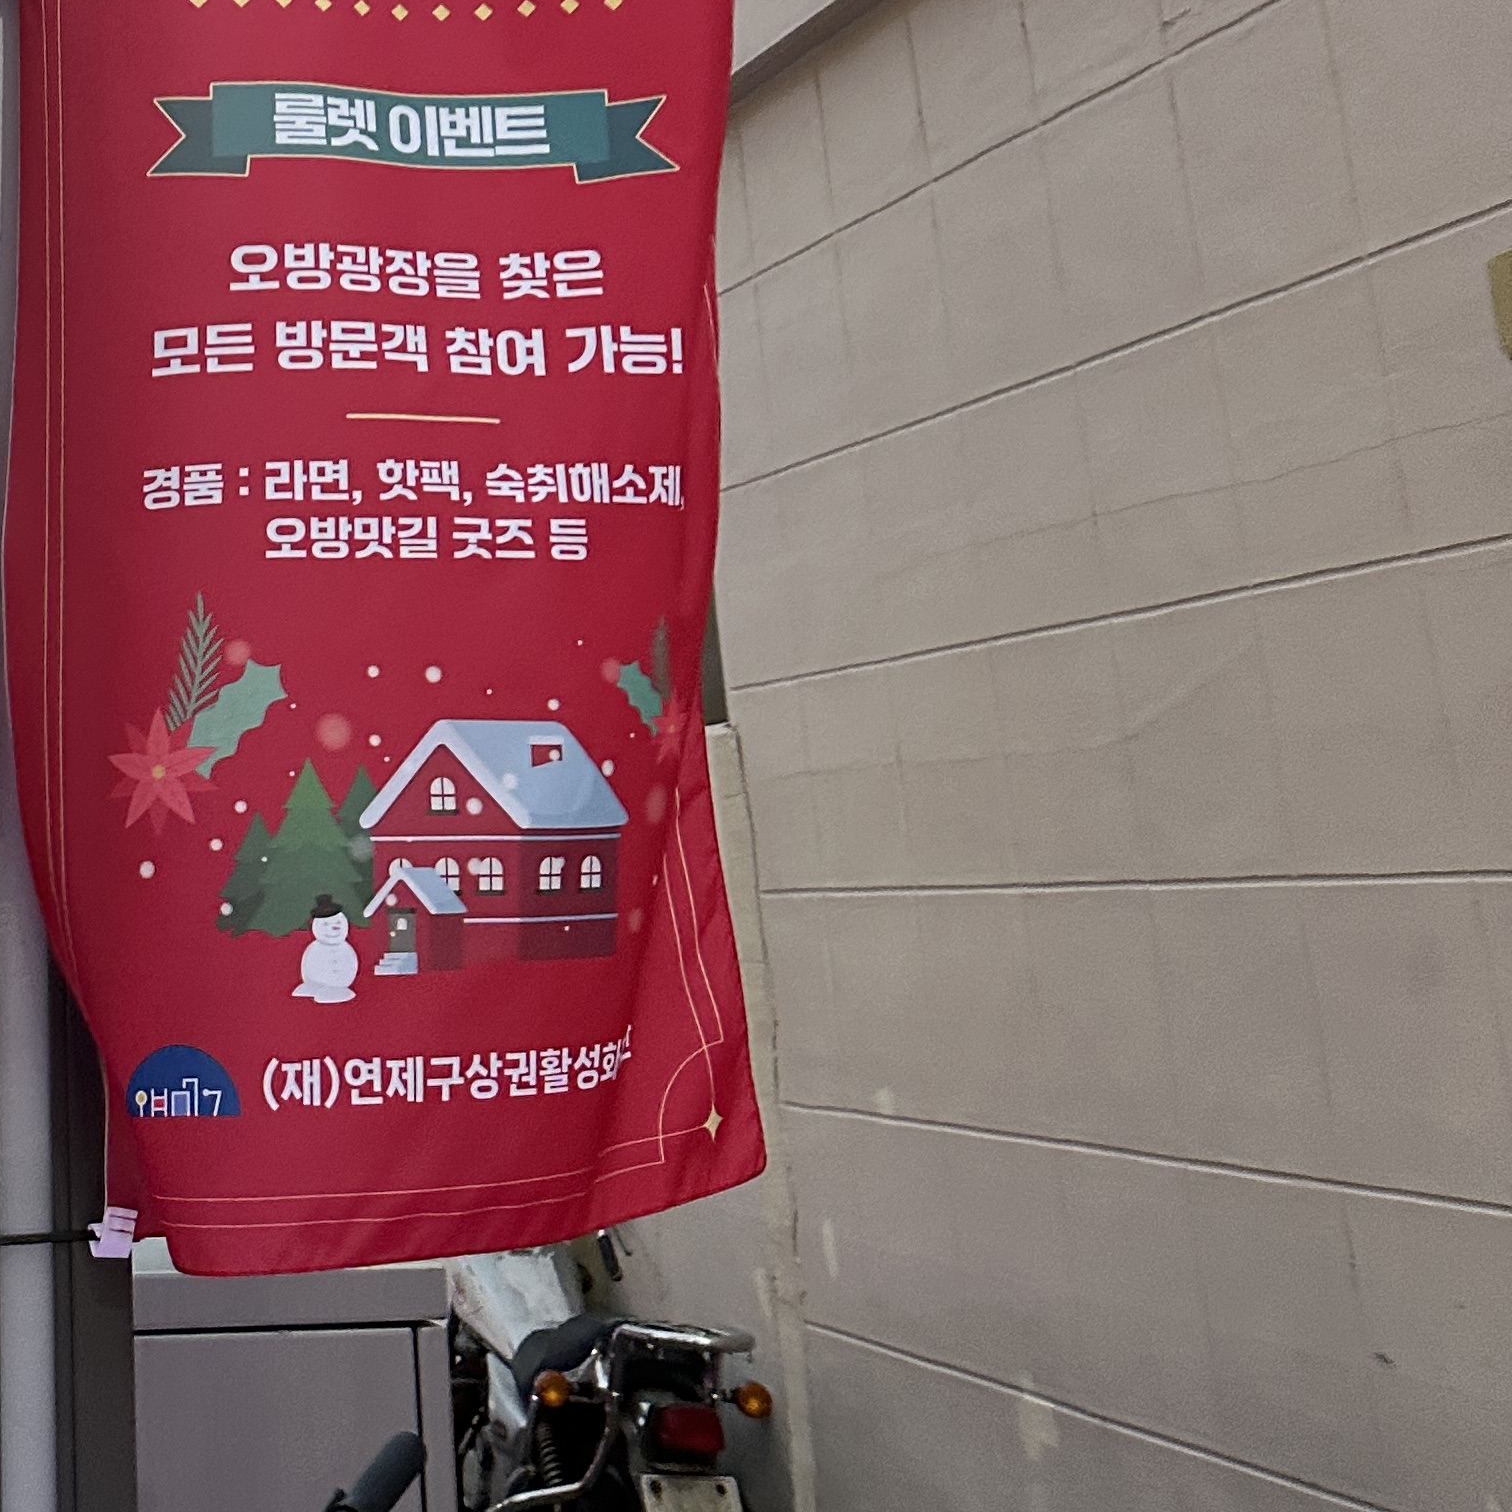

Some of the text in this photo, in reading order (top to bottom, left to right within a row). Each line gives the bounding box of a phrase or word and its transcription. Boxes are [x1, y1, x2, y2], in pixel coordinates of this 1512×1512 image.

[273, 92, 550, 157] 룰렛 이벤트
[229, 242, 604, 300] 오방광장을 찾은
[151, 320, 684, 377] 모든 방문객 참여 가능!
[143, 462, 224, 510] 경품
[264, 459, 362, 506] 라면,
[377, 458, 473, 506] 핫팩,
[485, 462, 685, 510] 숙취해소제,
[264, 516, 588, 561] 오방맛길 굿즈 등
